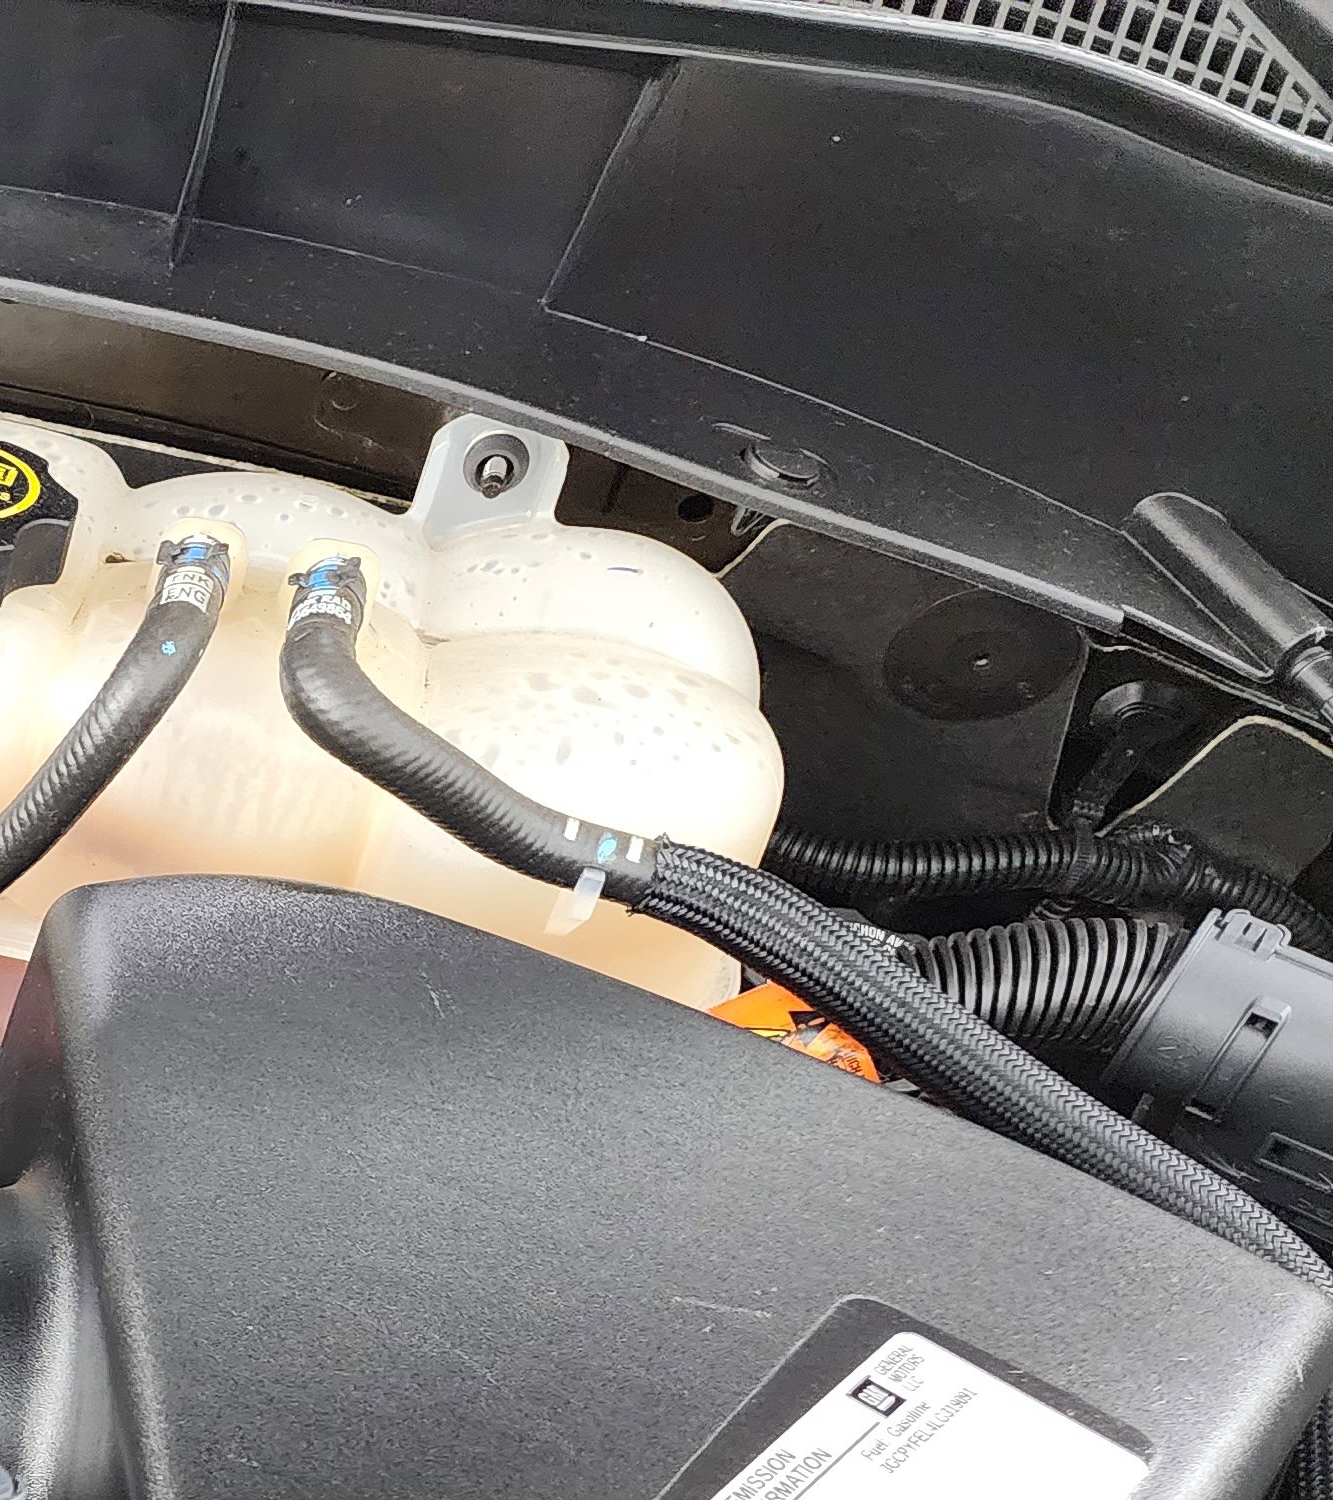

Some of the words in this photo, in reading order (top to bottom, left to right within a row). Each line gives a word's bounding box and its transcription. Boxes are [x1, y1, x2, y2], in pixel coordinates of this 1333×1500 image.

[873, 1345, 914, 1376] GENERAL
[888, 1353, 925, 1383] MOTORS
[886, 1401, 931, 1438] Gasoline
